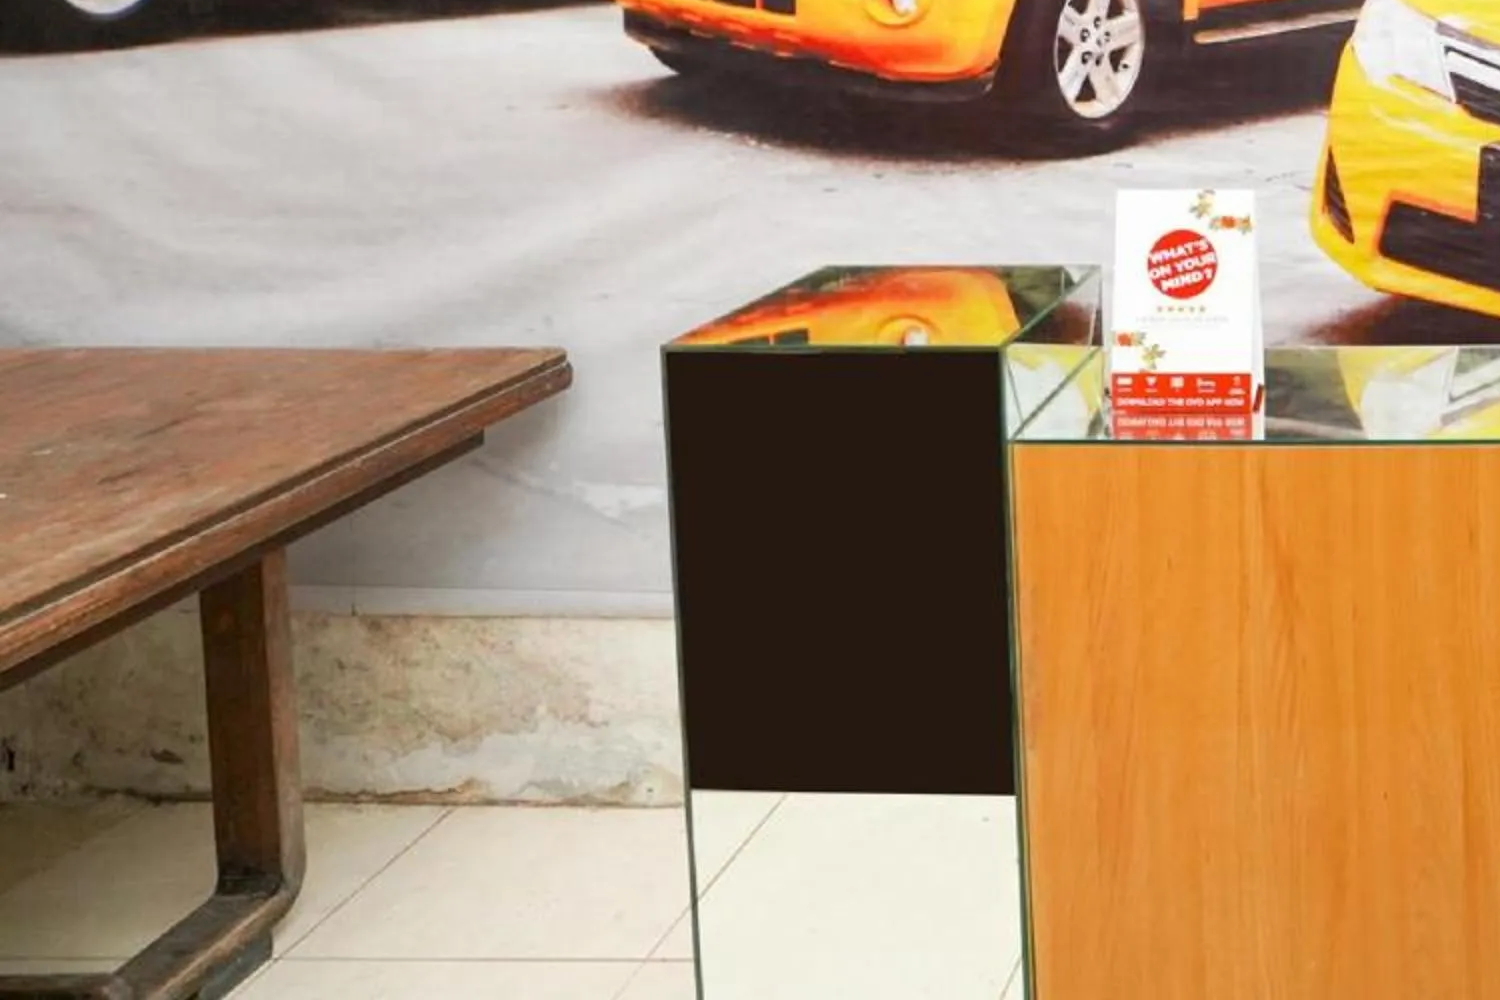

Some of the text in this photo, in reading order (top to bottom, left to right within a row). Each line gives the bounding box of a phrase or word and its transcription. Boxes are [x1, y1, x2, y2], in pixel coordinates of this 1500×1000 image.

[1149, 237, 1209, 264] WHAT'S
[1150, 252, 1217, 279] ON YOUR
